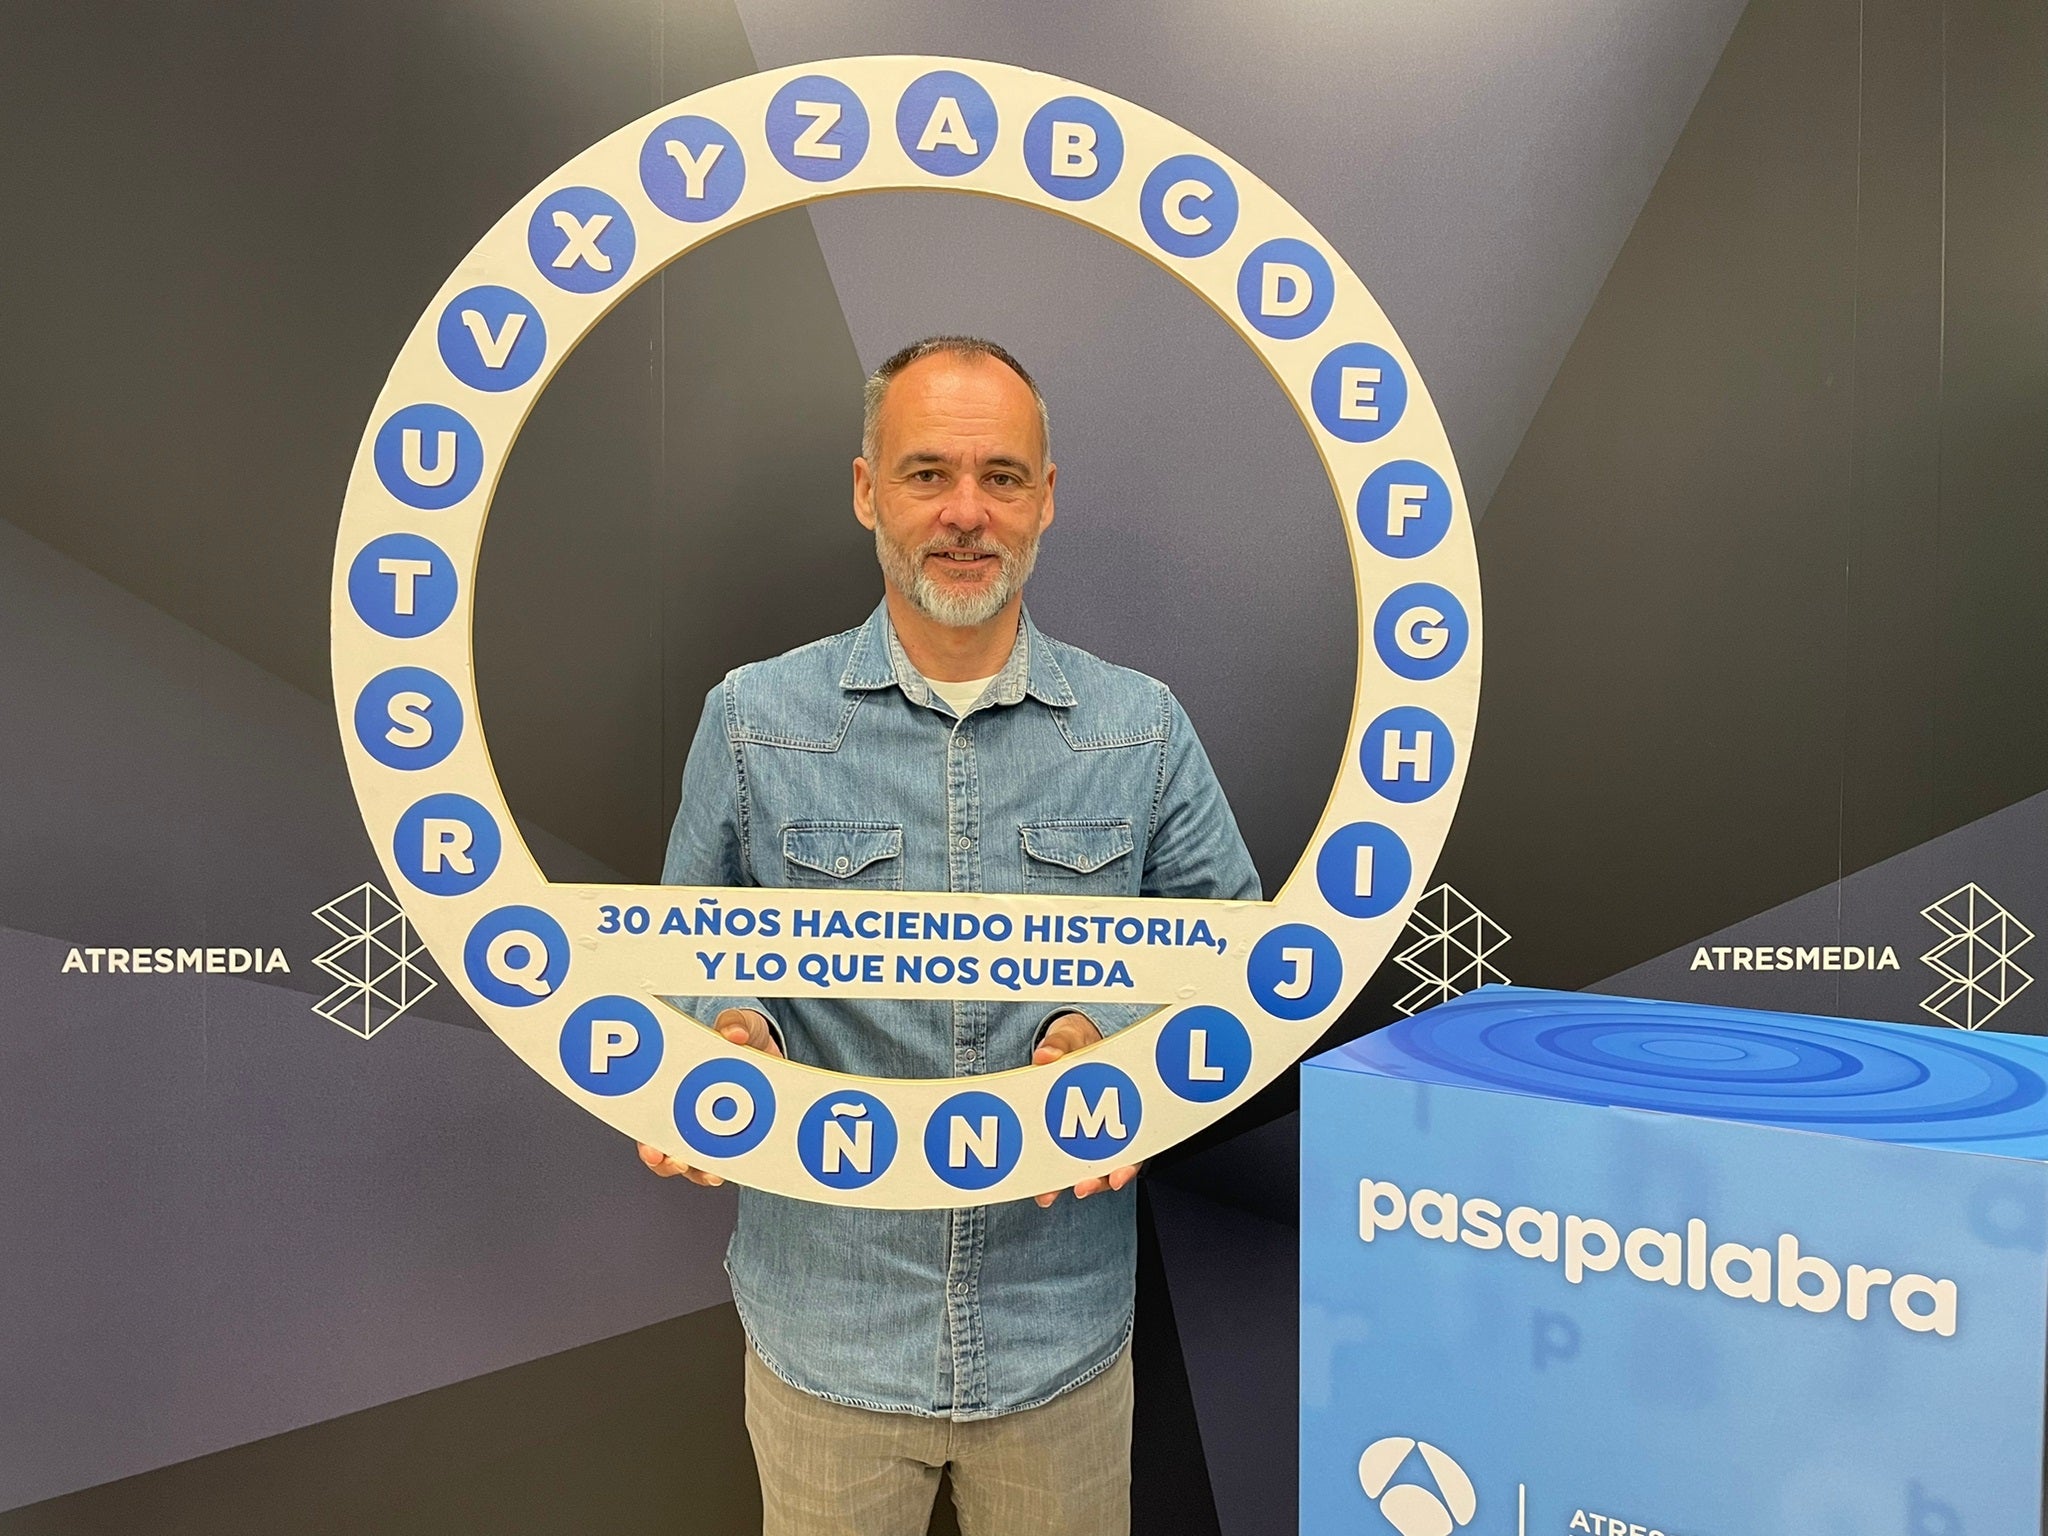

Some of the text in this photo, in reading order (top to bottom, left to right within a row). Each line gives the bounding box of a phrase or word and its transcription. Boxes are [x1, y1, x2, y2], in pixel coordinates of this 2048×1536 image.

[378, 95, 1449, 1173] A B C D E F G H I J L M N Ñ O P Q R S T U V X Y Z
[598, 898, 1227, 955] 30 AÑOS HACIENDO HISTORIA,
[61, 947, 291, 974] ATRESMEDIA
[696, 952, 1134, 991] Y LO QUE NOS QUEDA
[1689, 946, 1901, 971] ATRESMEDIA
[1359, 1178, 1958, 1337] pasapalabra
